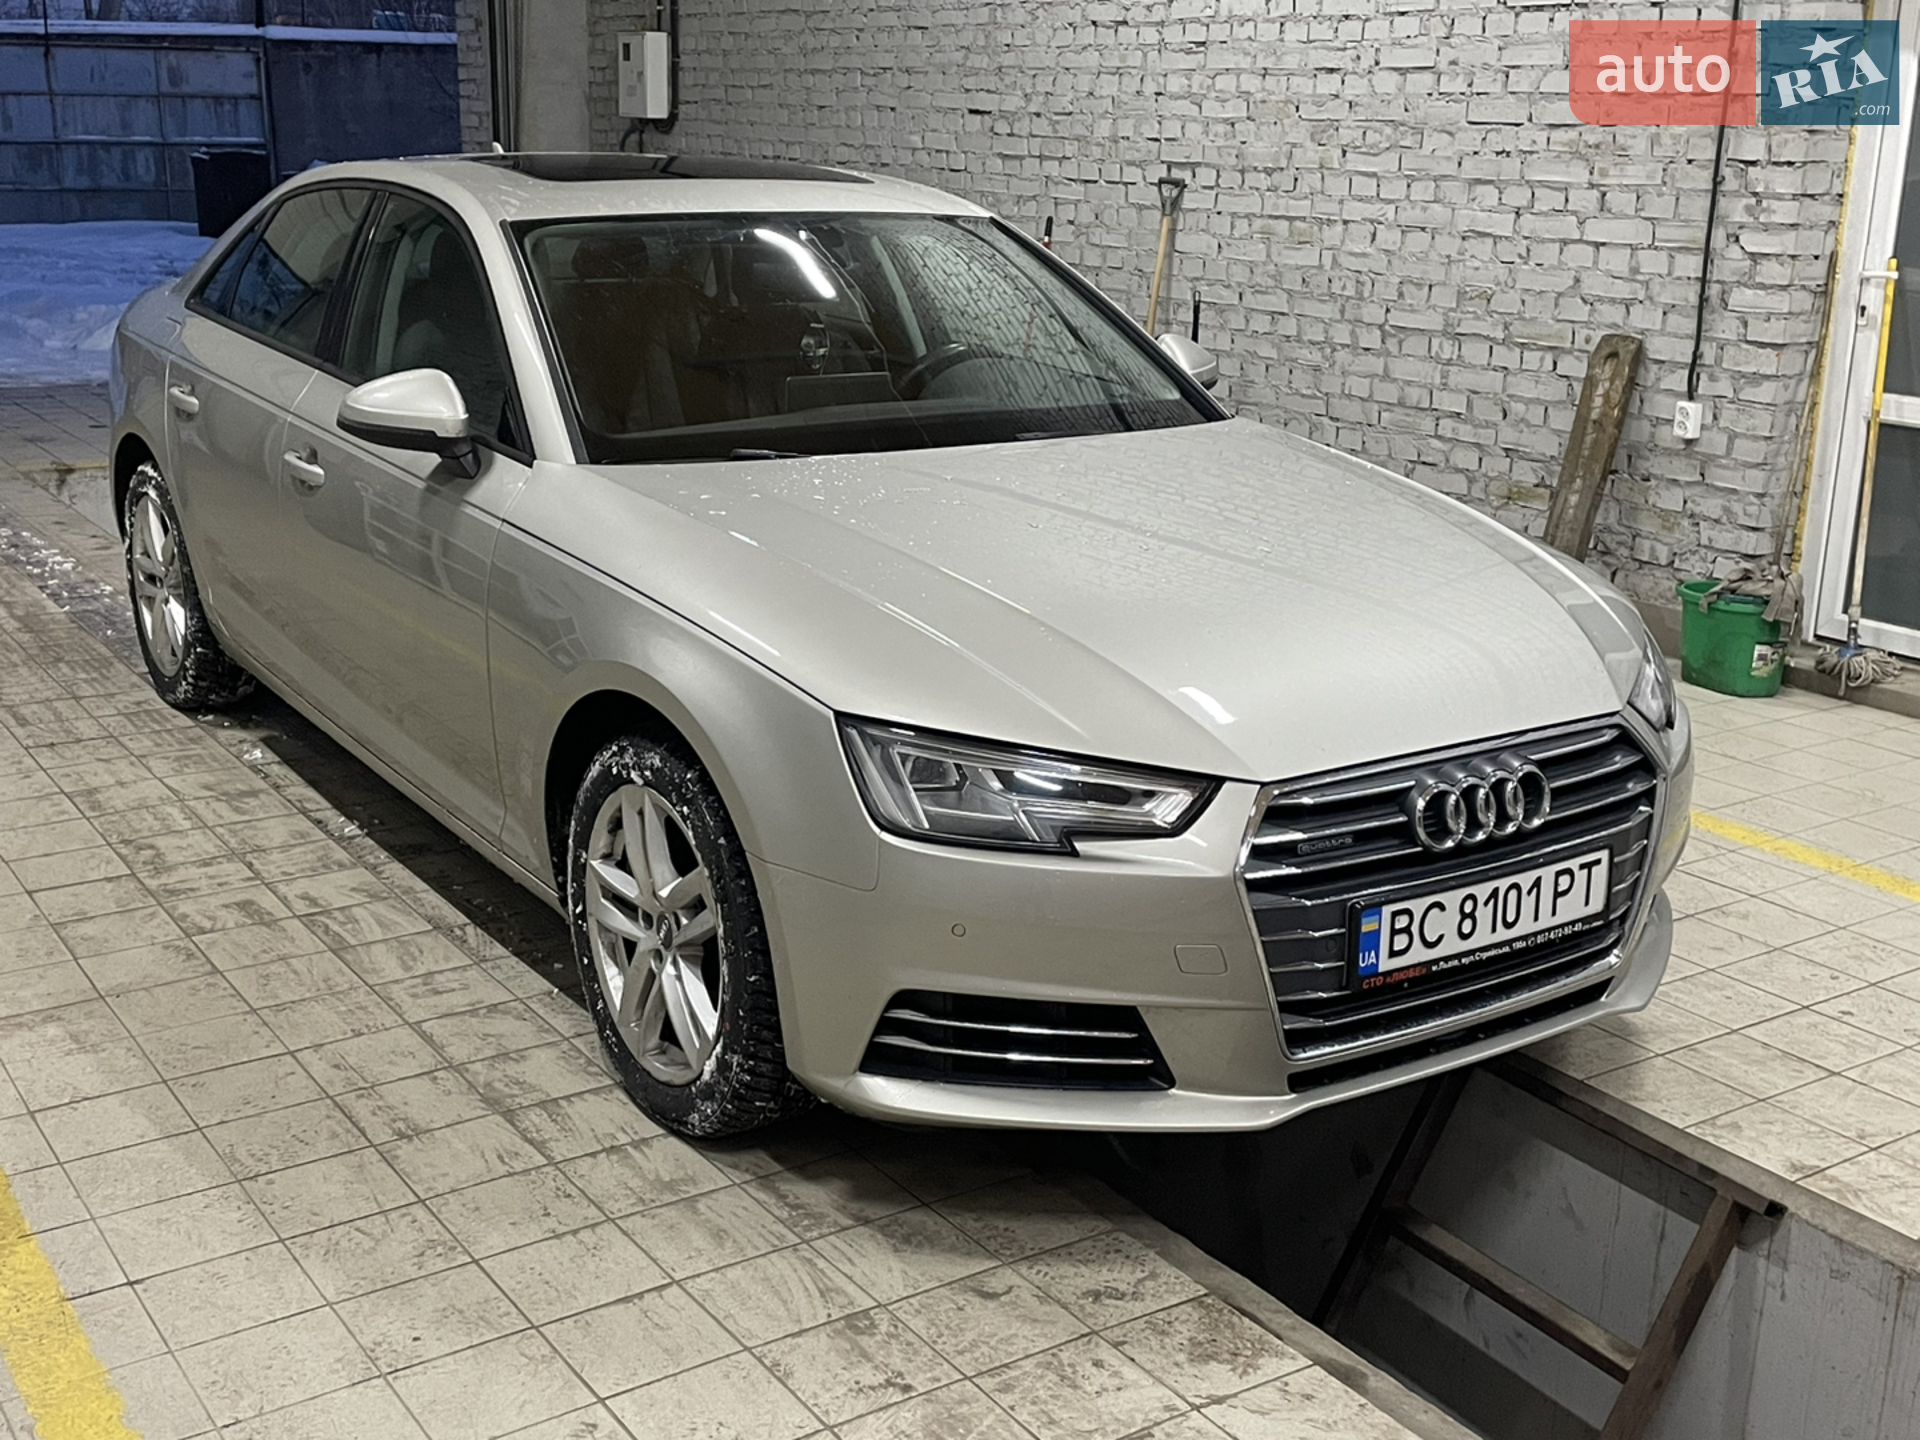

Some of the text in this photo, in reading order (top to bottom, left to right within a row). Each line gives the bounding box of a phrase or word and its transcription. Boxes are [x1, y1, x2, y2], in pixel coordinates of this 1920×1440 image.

[1388, 857, 1602, 959] BC 8101 PT
[1359, 950, 1378, 968] UA
